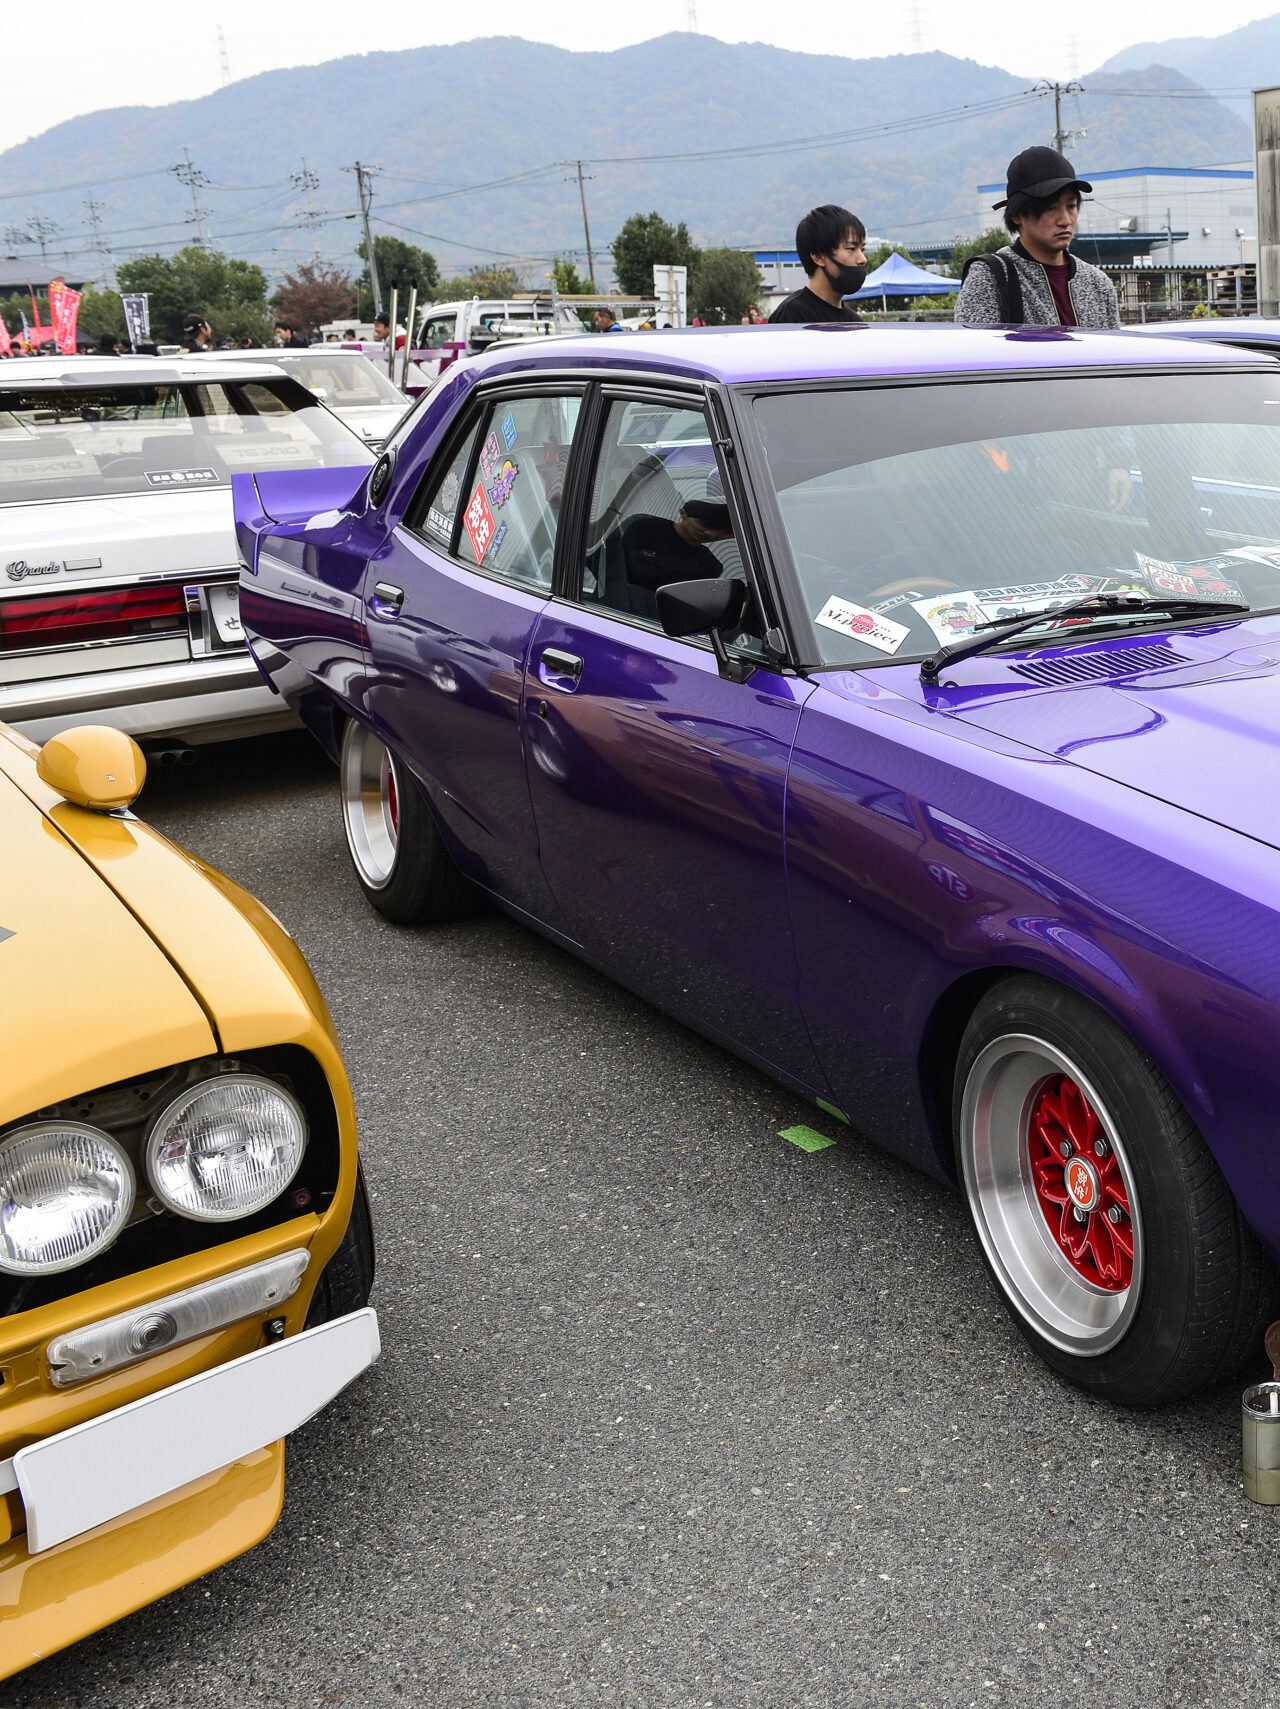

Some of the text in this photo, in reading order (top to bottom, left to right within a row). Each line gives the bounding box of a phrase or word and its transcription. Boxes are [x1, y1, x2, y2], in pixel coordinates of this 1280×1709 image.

[6, 560, 61, 582] Grande
[1150, 568, 1191, 584] 2000
[1154, 577, 1198, 594] GT
[224, 616, 241, 630] せ
[821, 607, 900, 646] M.project
